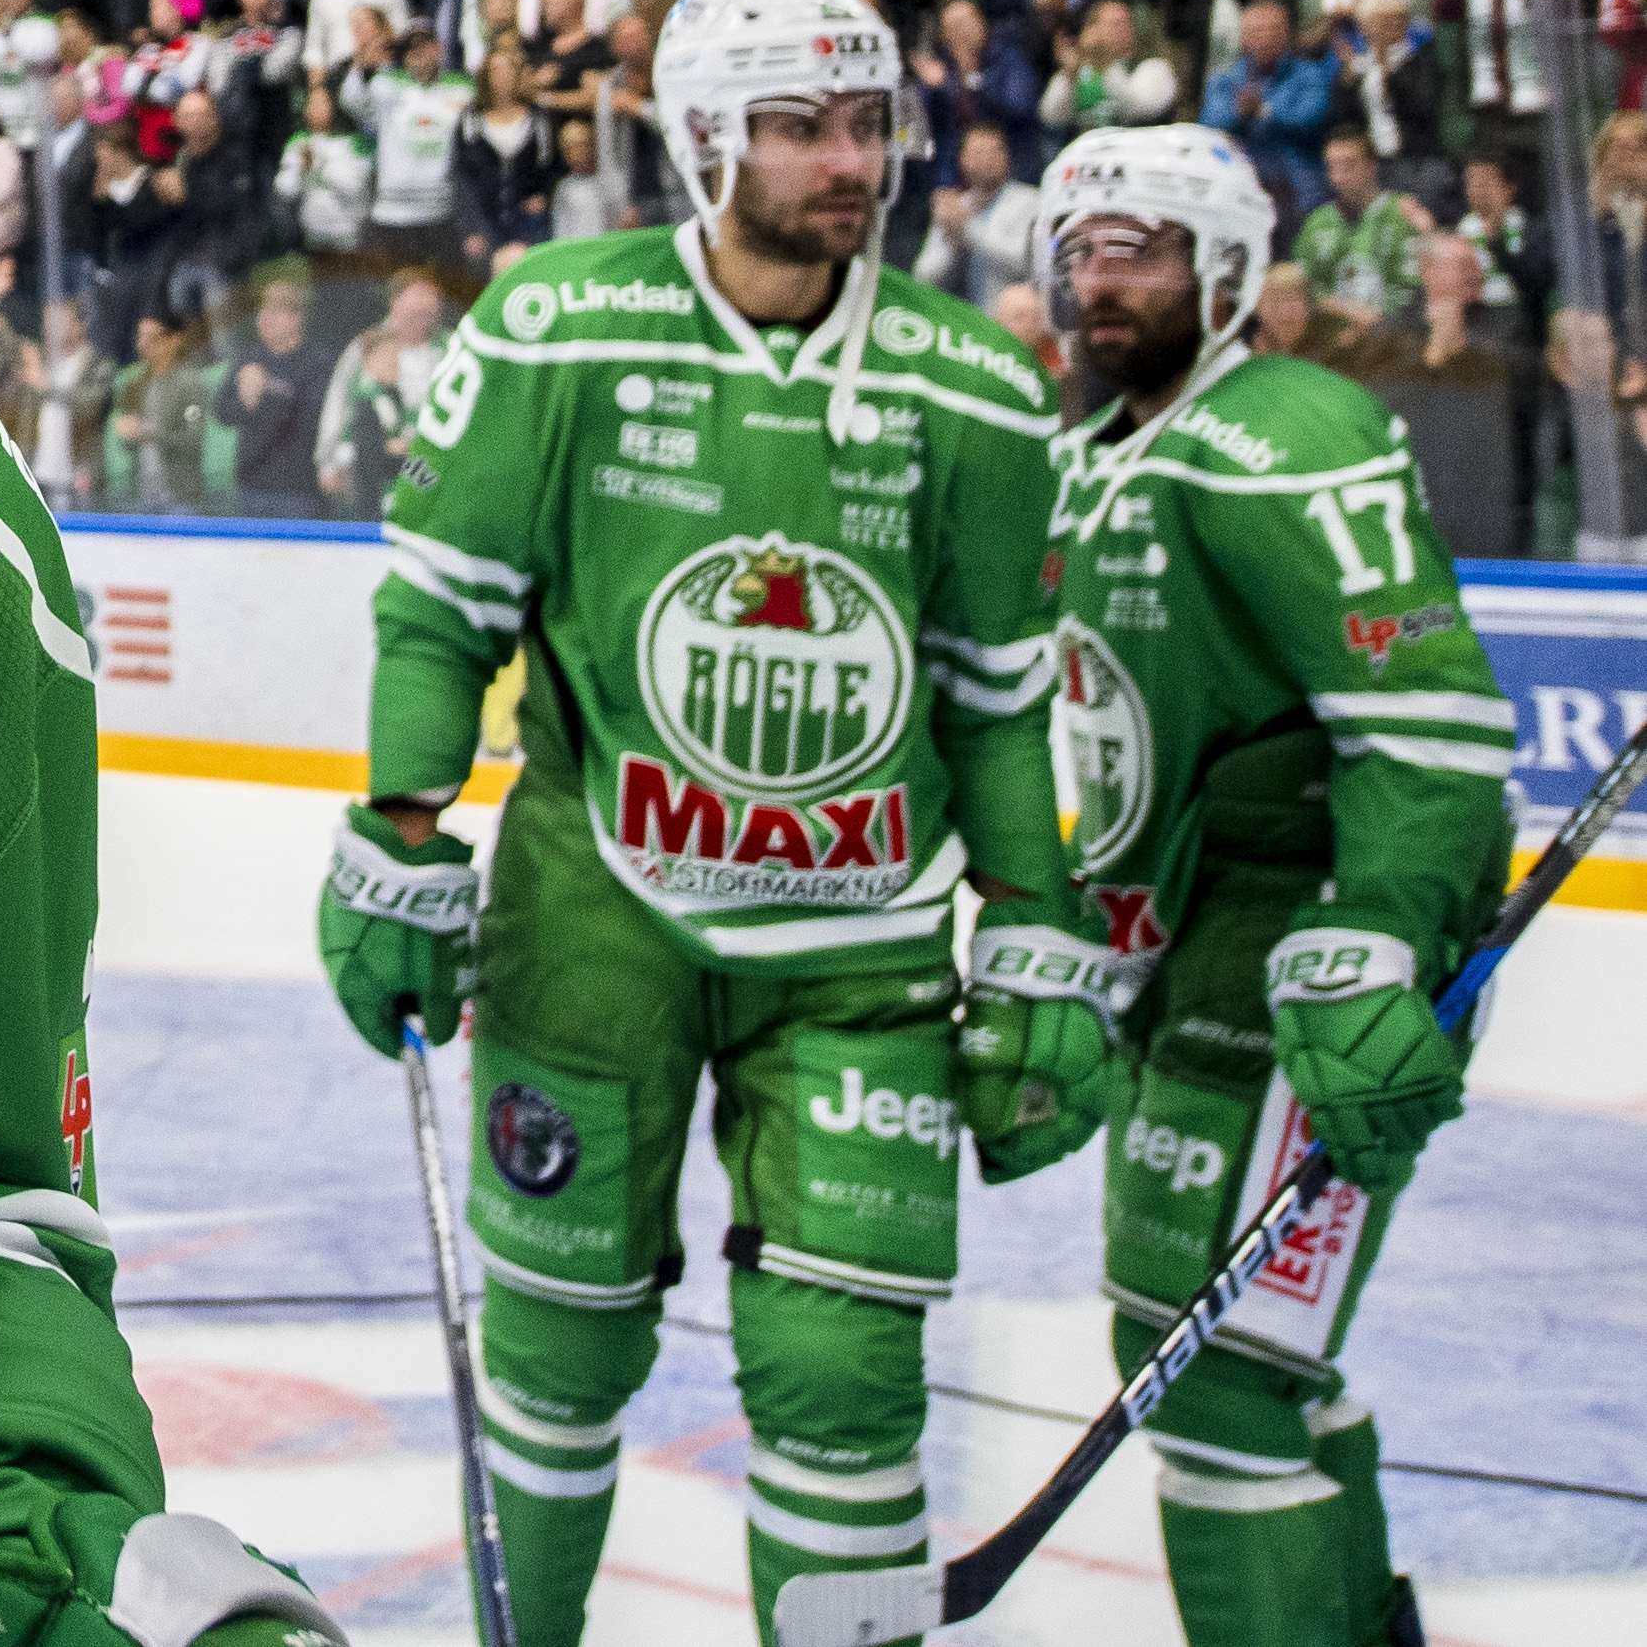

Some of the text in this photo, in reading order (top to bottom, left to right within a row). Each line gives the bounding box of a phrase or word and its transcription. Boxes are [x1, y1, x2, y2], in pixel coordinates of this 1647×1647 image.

[560, 277, 695, 316] Lindab
[1307, 482, 1415, 596] 17
[684, 639, 873, 778] RÖGLE
[617, 752, 906, 868] MAXI
[334, 853, 479, 916] AUER
[987, 946, 1111, 994] BAU
[1124, 1118, 1224, 1192] eep
